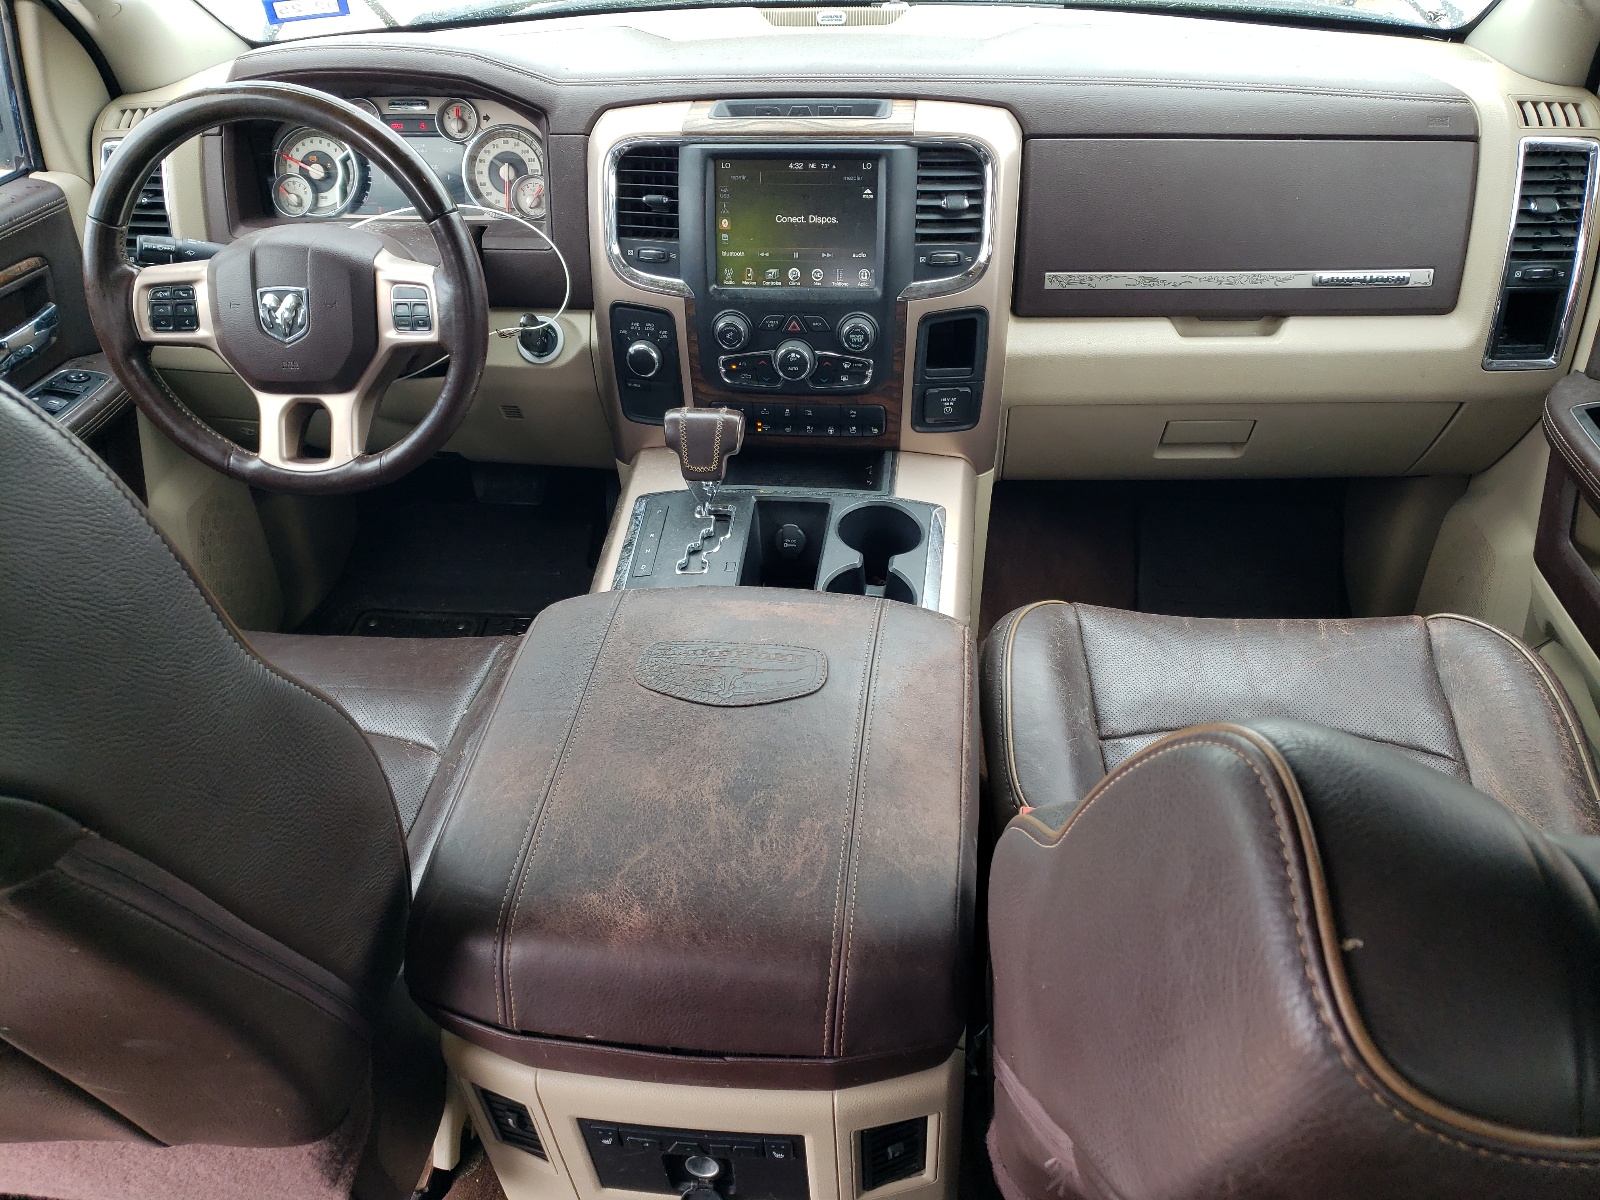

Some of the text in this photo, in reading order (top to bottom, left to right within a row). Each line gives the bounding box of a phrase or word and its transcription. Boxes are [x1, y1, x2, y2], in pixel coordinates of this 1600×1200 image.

[755, 106, 853, 117] RAM
[776, 214, 838, 224] Conect. Dispos.
